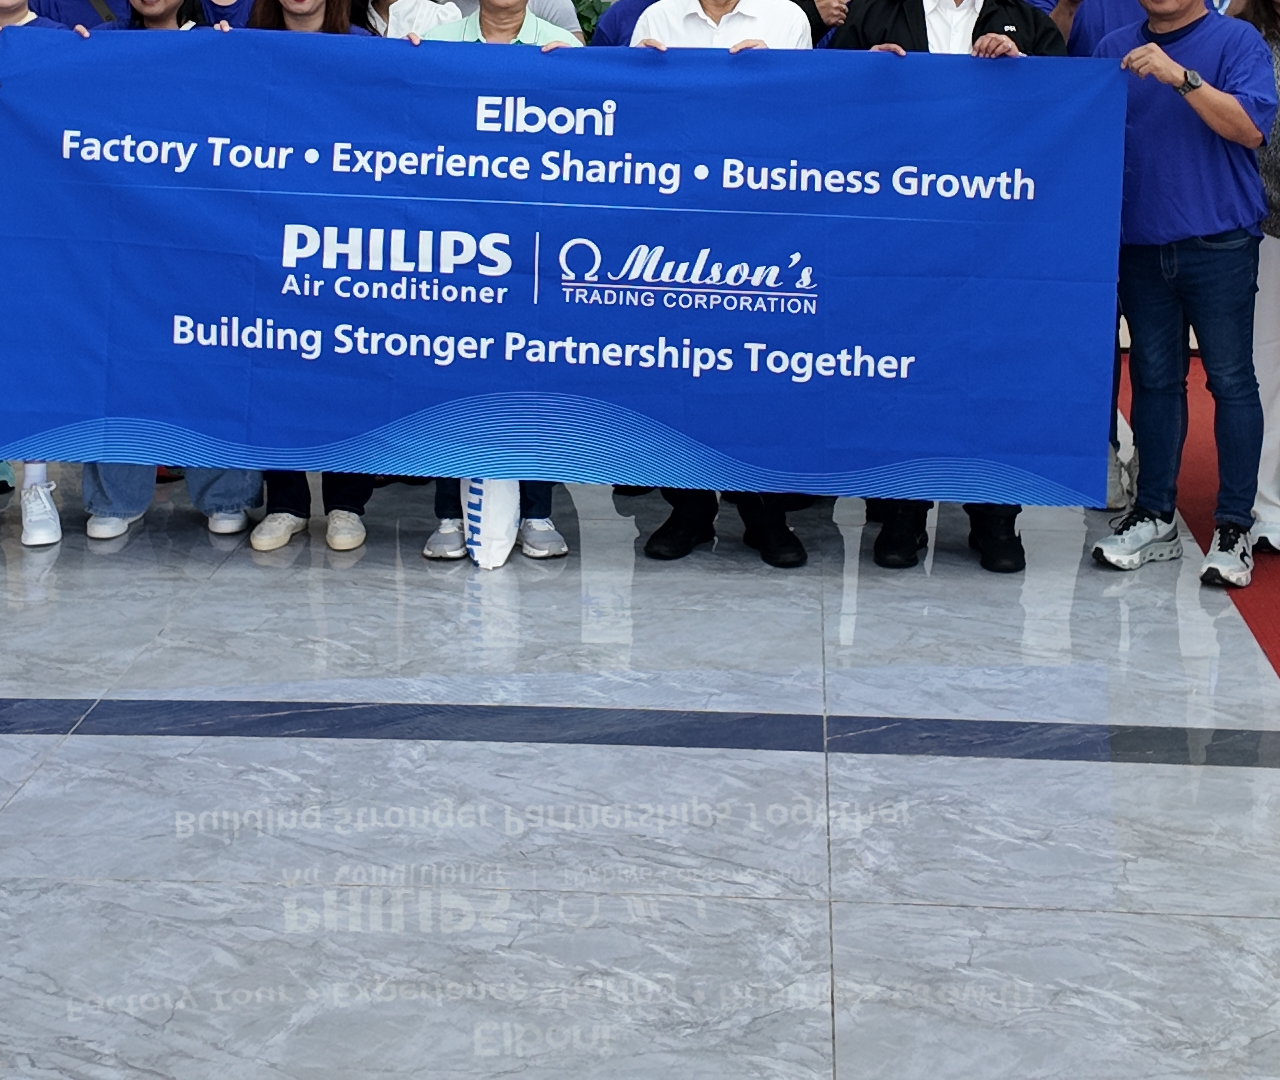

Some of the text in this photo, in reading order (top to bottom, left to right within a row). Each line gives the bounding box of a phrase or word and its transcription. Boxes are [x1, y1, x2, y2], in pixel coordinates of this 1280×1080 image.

[477, 96, 617, 136] Elboni
[62, 129, 1035, 200] Factory Tour Experience Sharing Business Growth
[282, 224, 512, 277] PHILIPS
[608, 244, 818, 290] Mulson's
[281, 273, 508, 304] Air Conditioner
[562, 288, 817, 315] TRADING CORPORATION
[173, 314, 916, 383] Building Stronger Partnerships Together
